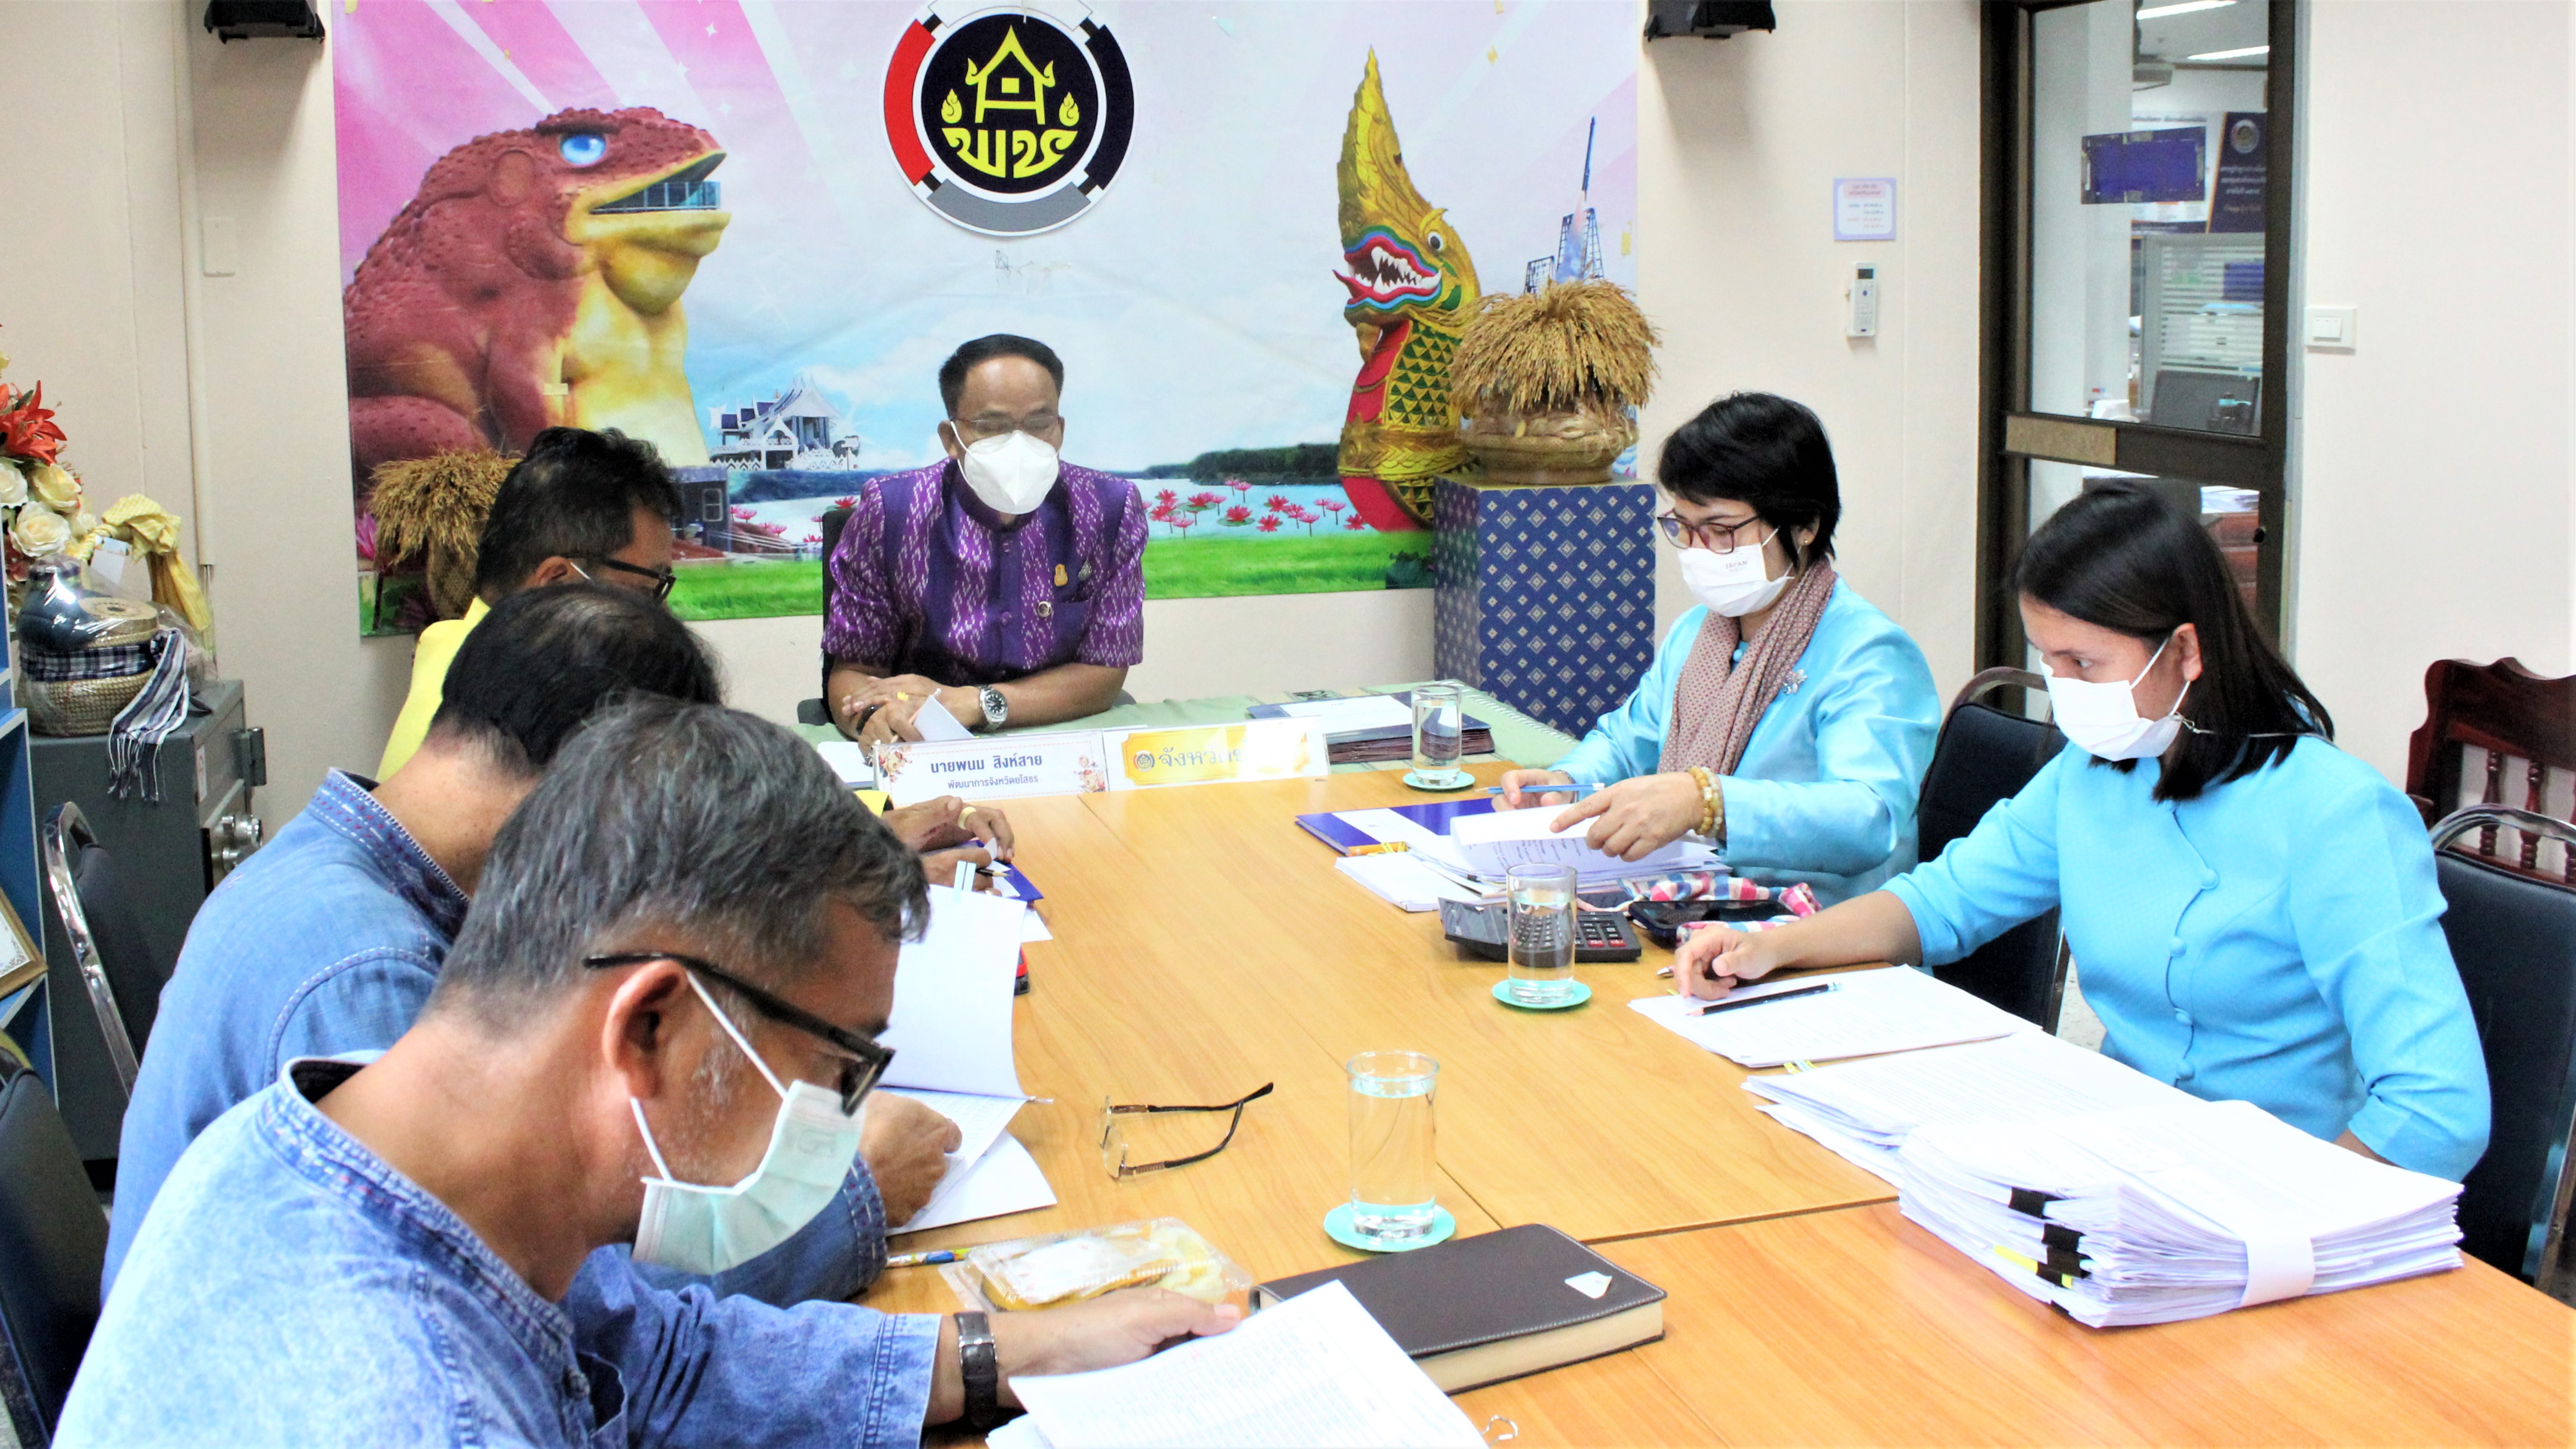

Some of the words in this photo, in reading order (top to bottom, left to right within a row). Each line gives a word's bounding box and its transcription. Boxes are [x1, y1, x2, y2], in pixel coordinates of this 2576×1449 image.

[930, 759, 984, 773] นายพนม
[993, 753, 1042, 768] สิงห์สาย
[947, 774, 1038, 789] พัฒนาการจังหวัดยโสธร
